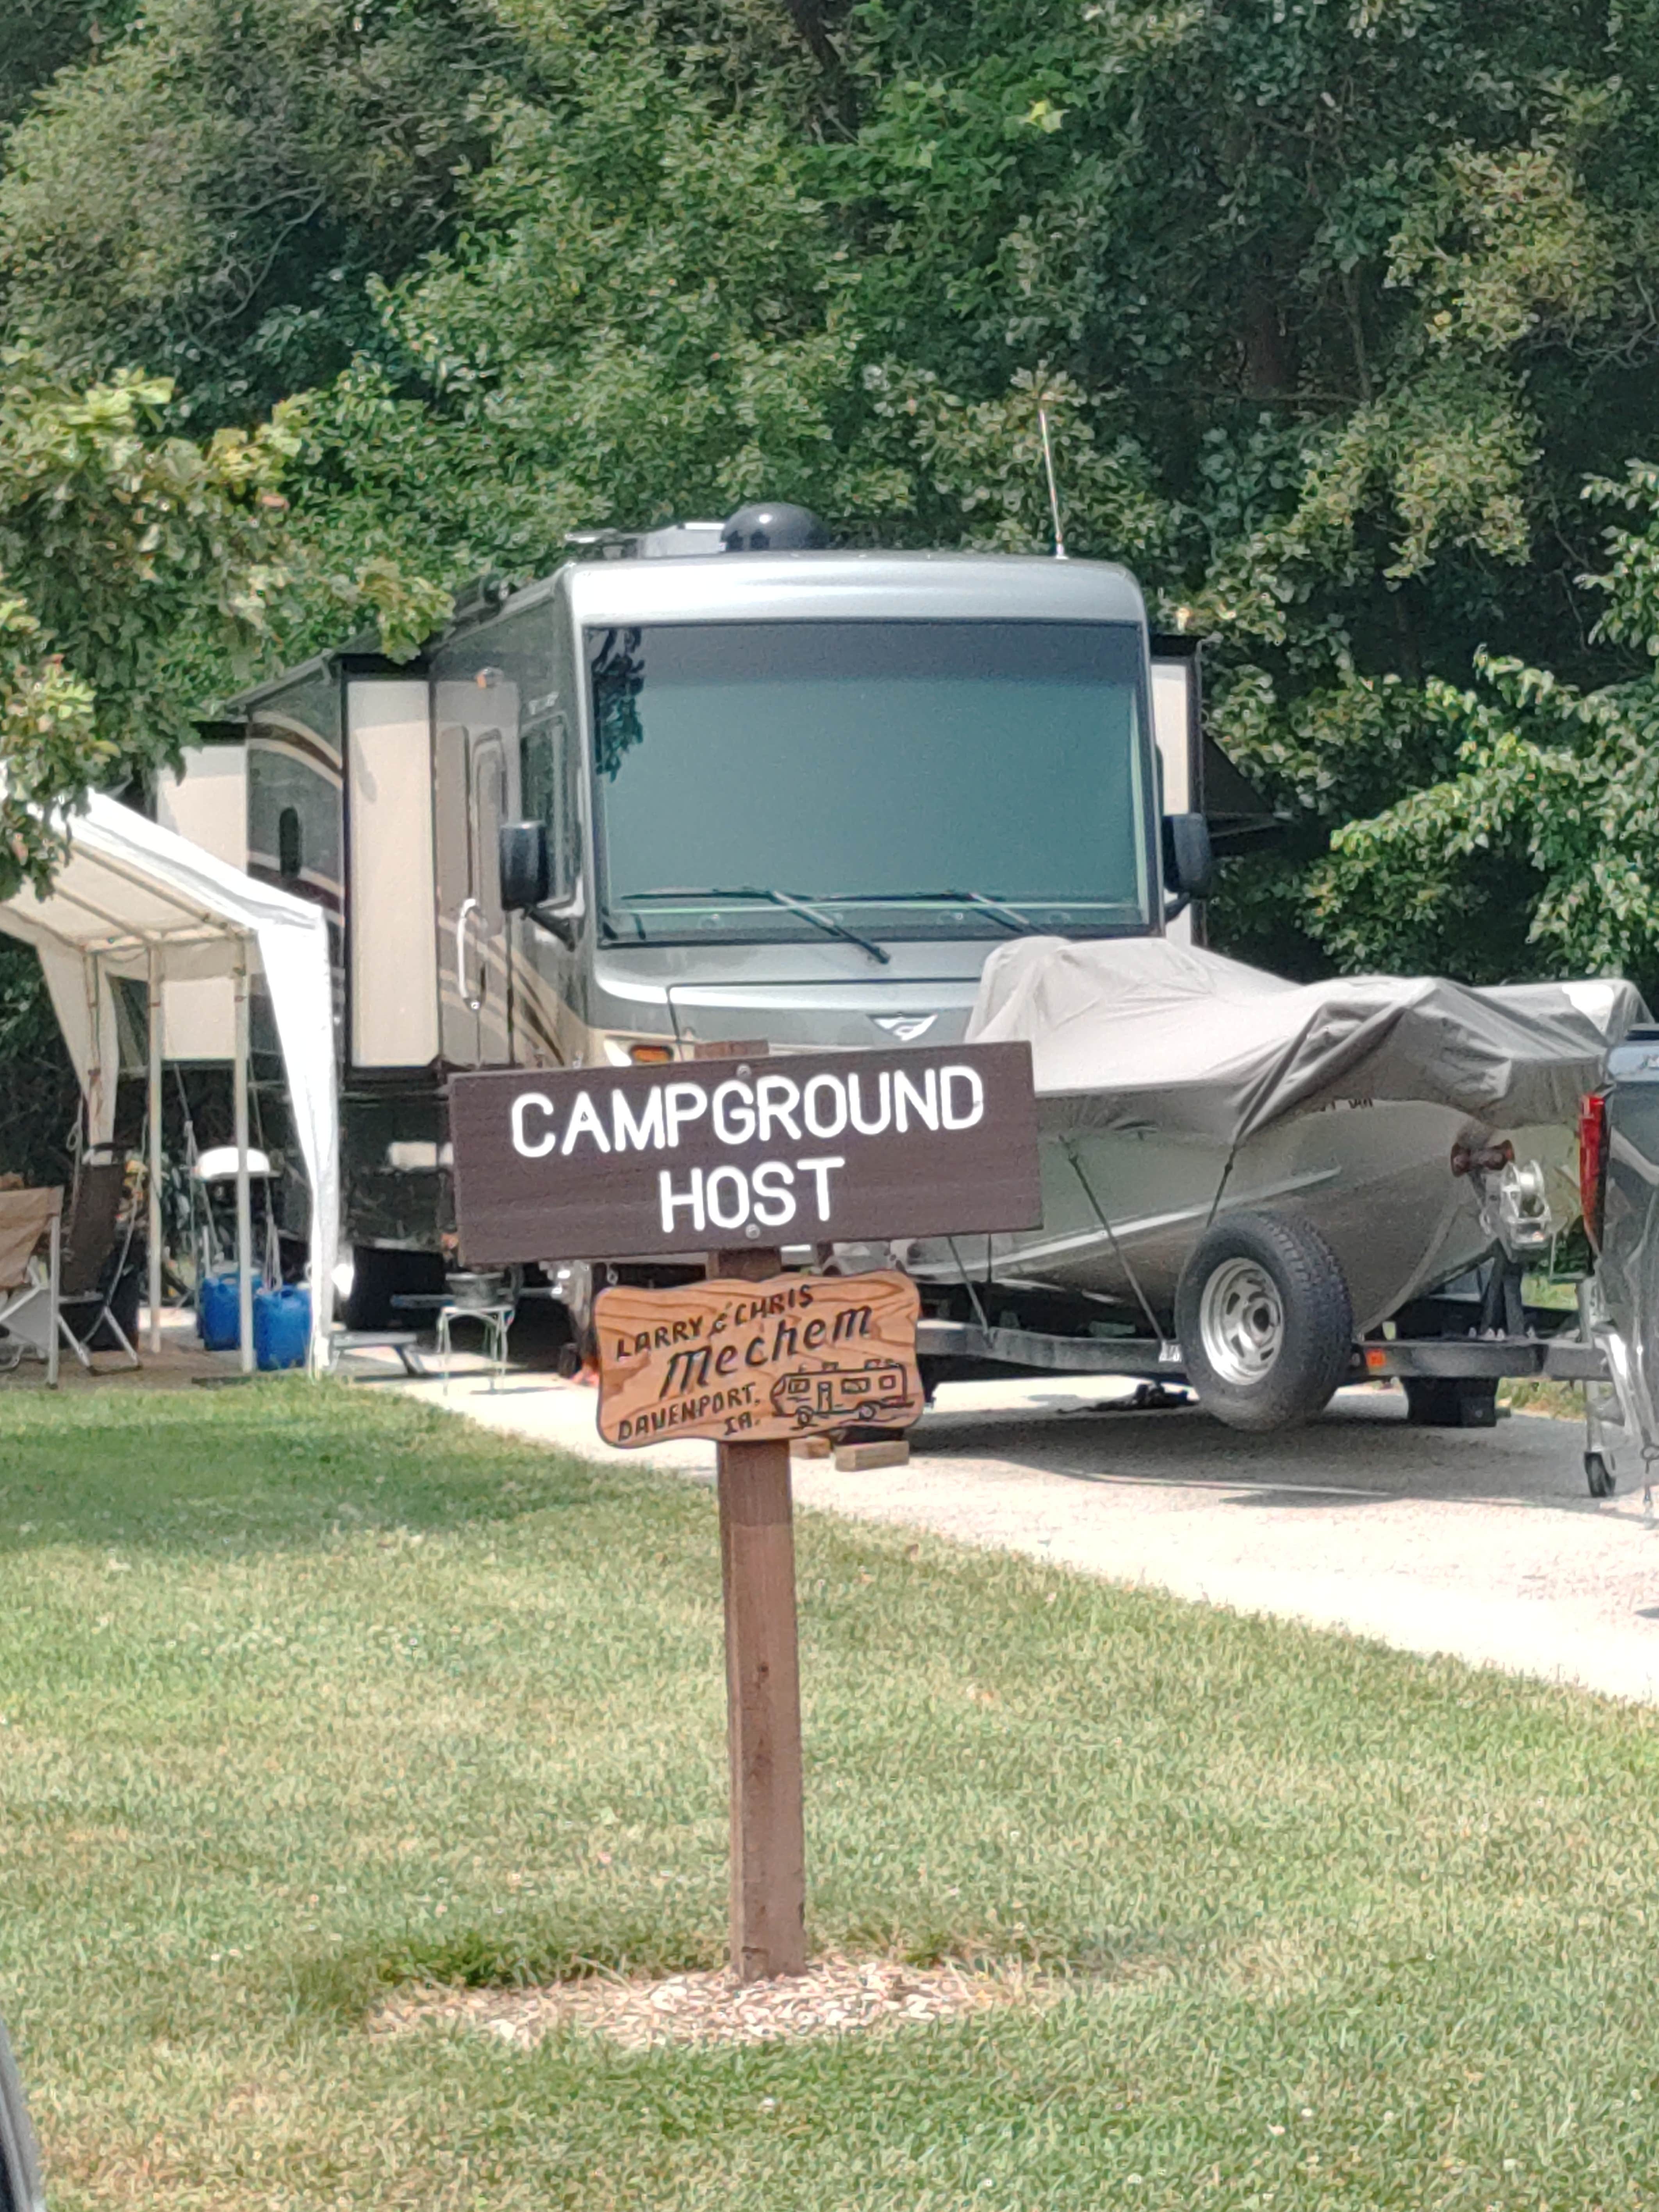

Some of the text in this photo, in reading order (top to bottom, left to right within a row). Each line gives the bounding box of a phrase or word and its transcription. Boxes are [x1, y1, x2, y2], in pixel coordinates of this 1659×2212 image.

[510, 1065, 984, 1158] CAMPGROUND
[659, 1157, 845, 1233] HOST
[616, 1315, 703, 1362] LARRY
[735, 1284, 814, 1325] CHRIS
